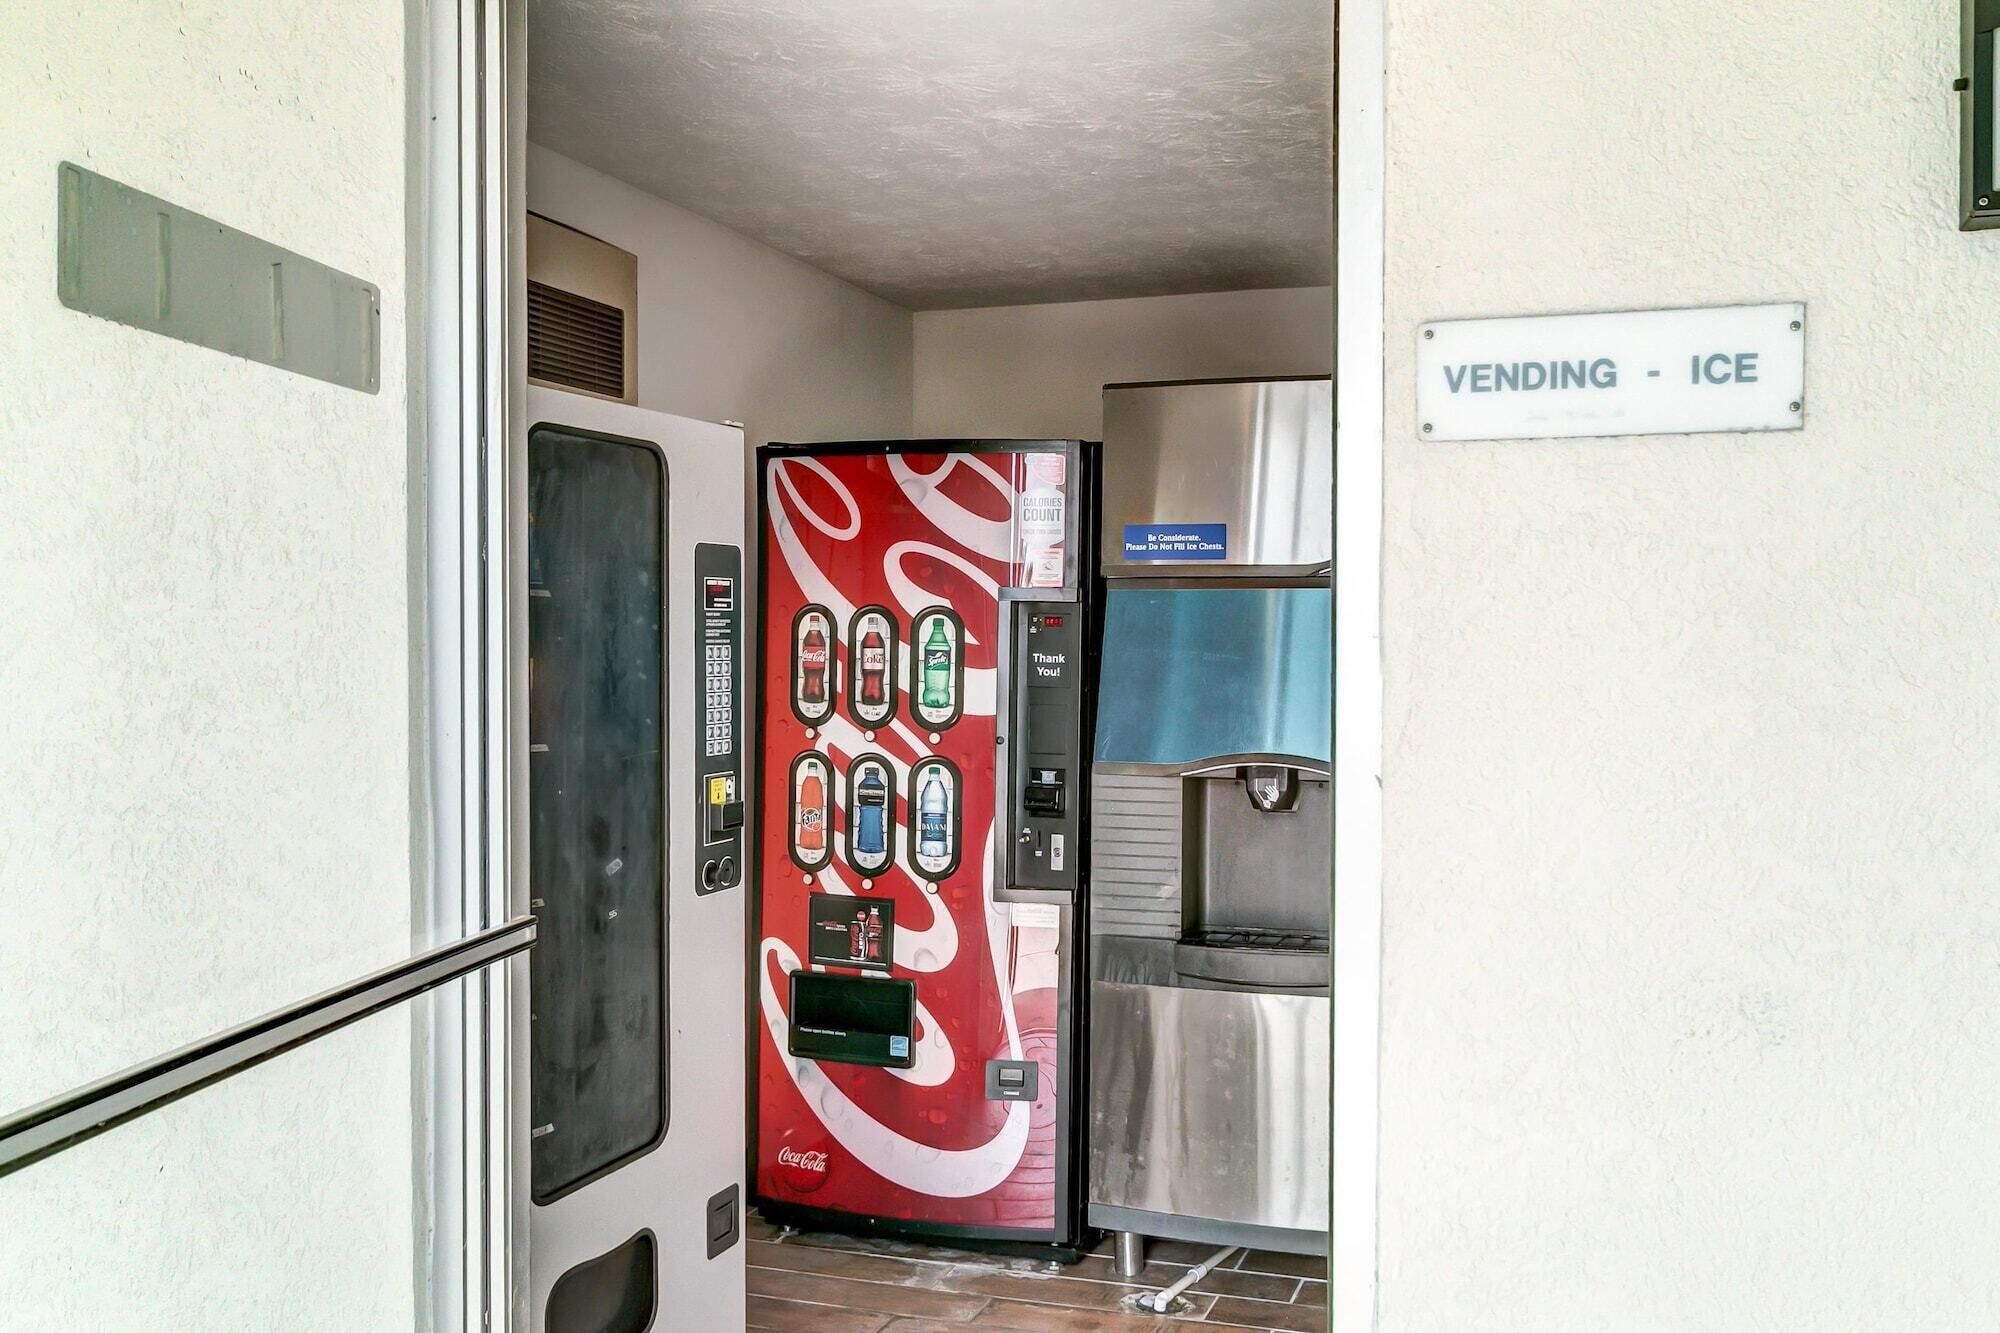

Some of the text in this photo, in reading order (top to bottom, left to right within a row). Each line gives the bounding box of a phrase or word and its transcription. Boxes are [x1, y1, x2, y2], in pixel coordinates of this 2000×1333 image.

[1443, 357, 1617, 394] VENDING
[1691, 352, 1759, 386] ICE
[1023, 497, 1063, 508] CALORIES
[1023, 508, 1063, 522] COUNT
[1125, 543, 1147, 551] Please
[1148, 543, 1159, 551] Do
[1160, 543, 1173, 551] Not
[1174, 543, 1185, 551] Fill
[1186, 543, 1198, 551] Ice
[1032, 653, 1066, 664] Thank
[1036, 666, 1061, 677] You!
[778, 1145, 829, 1172] Coca-Cola
